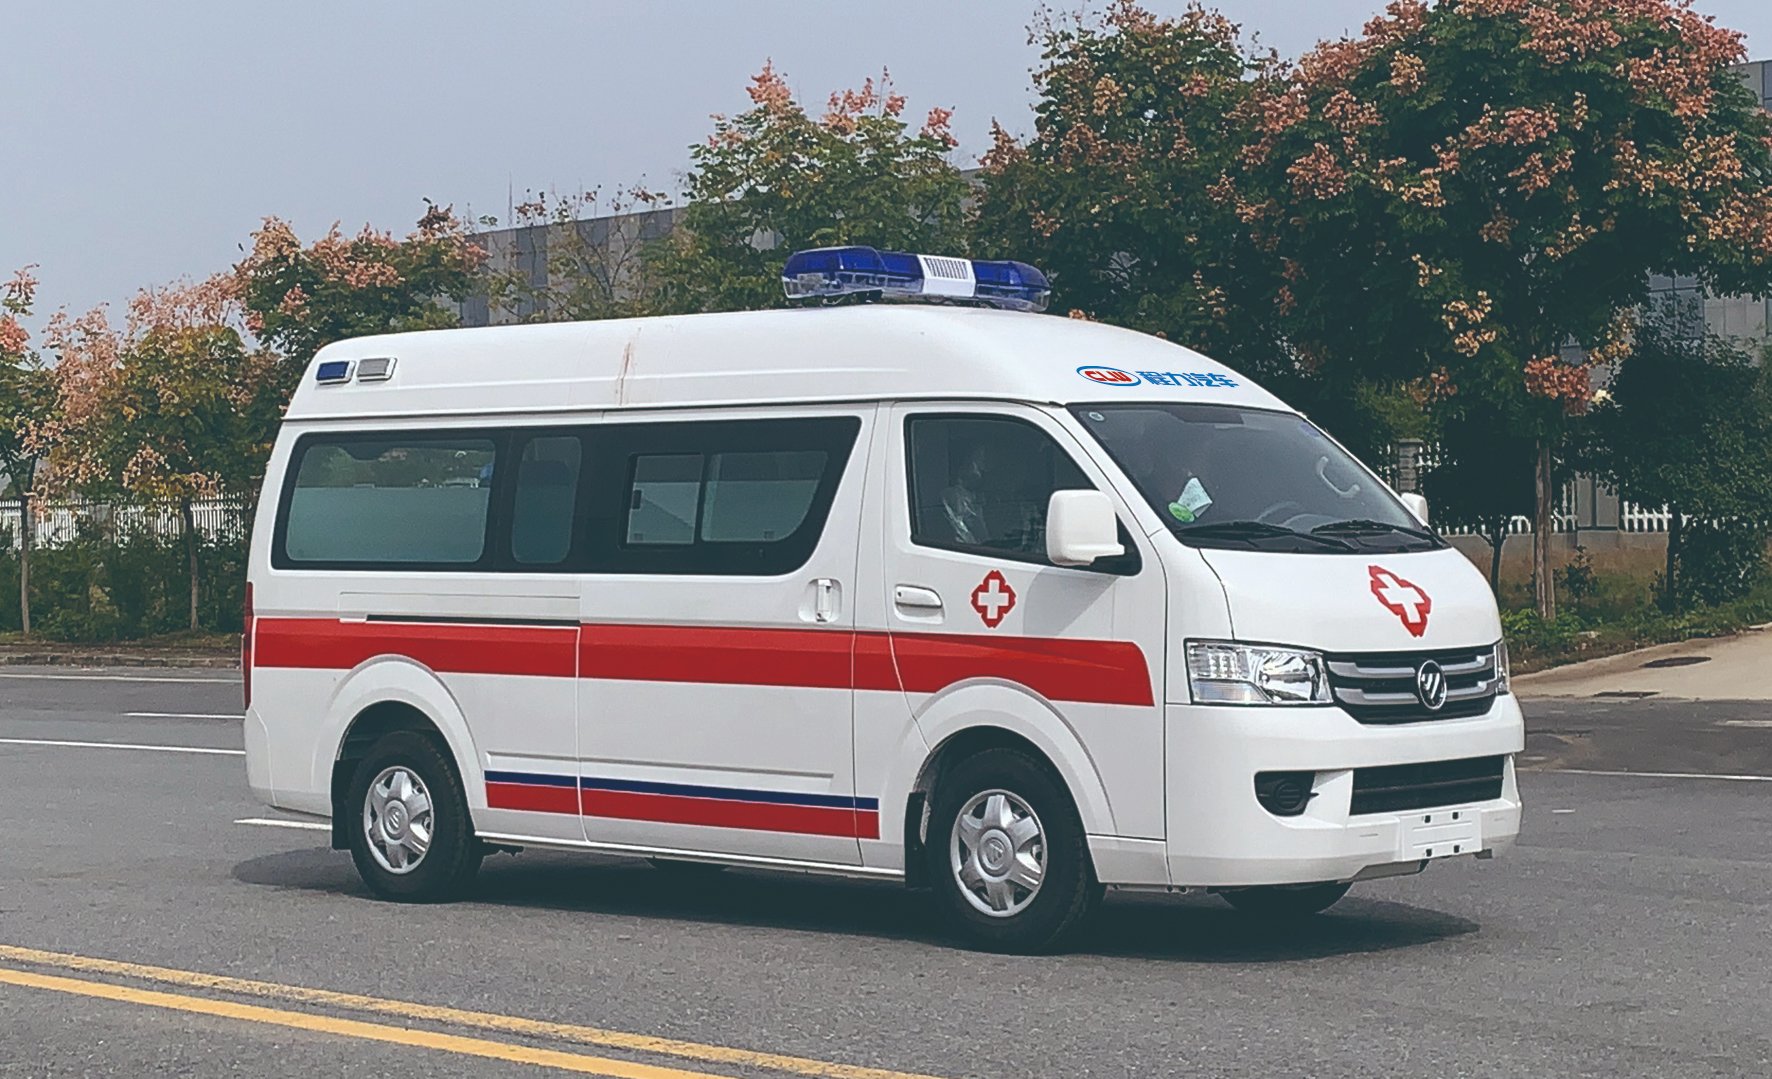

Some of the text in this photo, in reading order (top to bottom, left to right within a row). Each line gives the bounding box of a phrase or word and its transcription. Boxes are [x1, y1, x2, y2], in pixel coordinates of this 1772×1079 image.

[1084, 371, 1132, 383] CLW
[1136, 371, 1239, 387] 程力汽车
